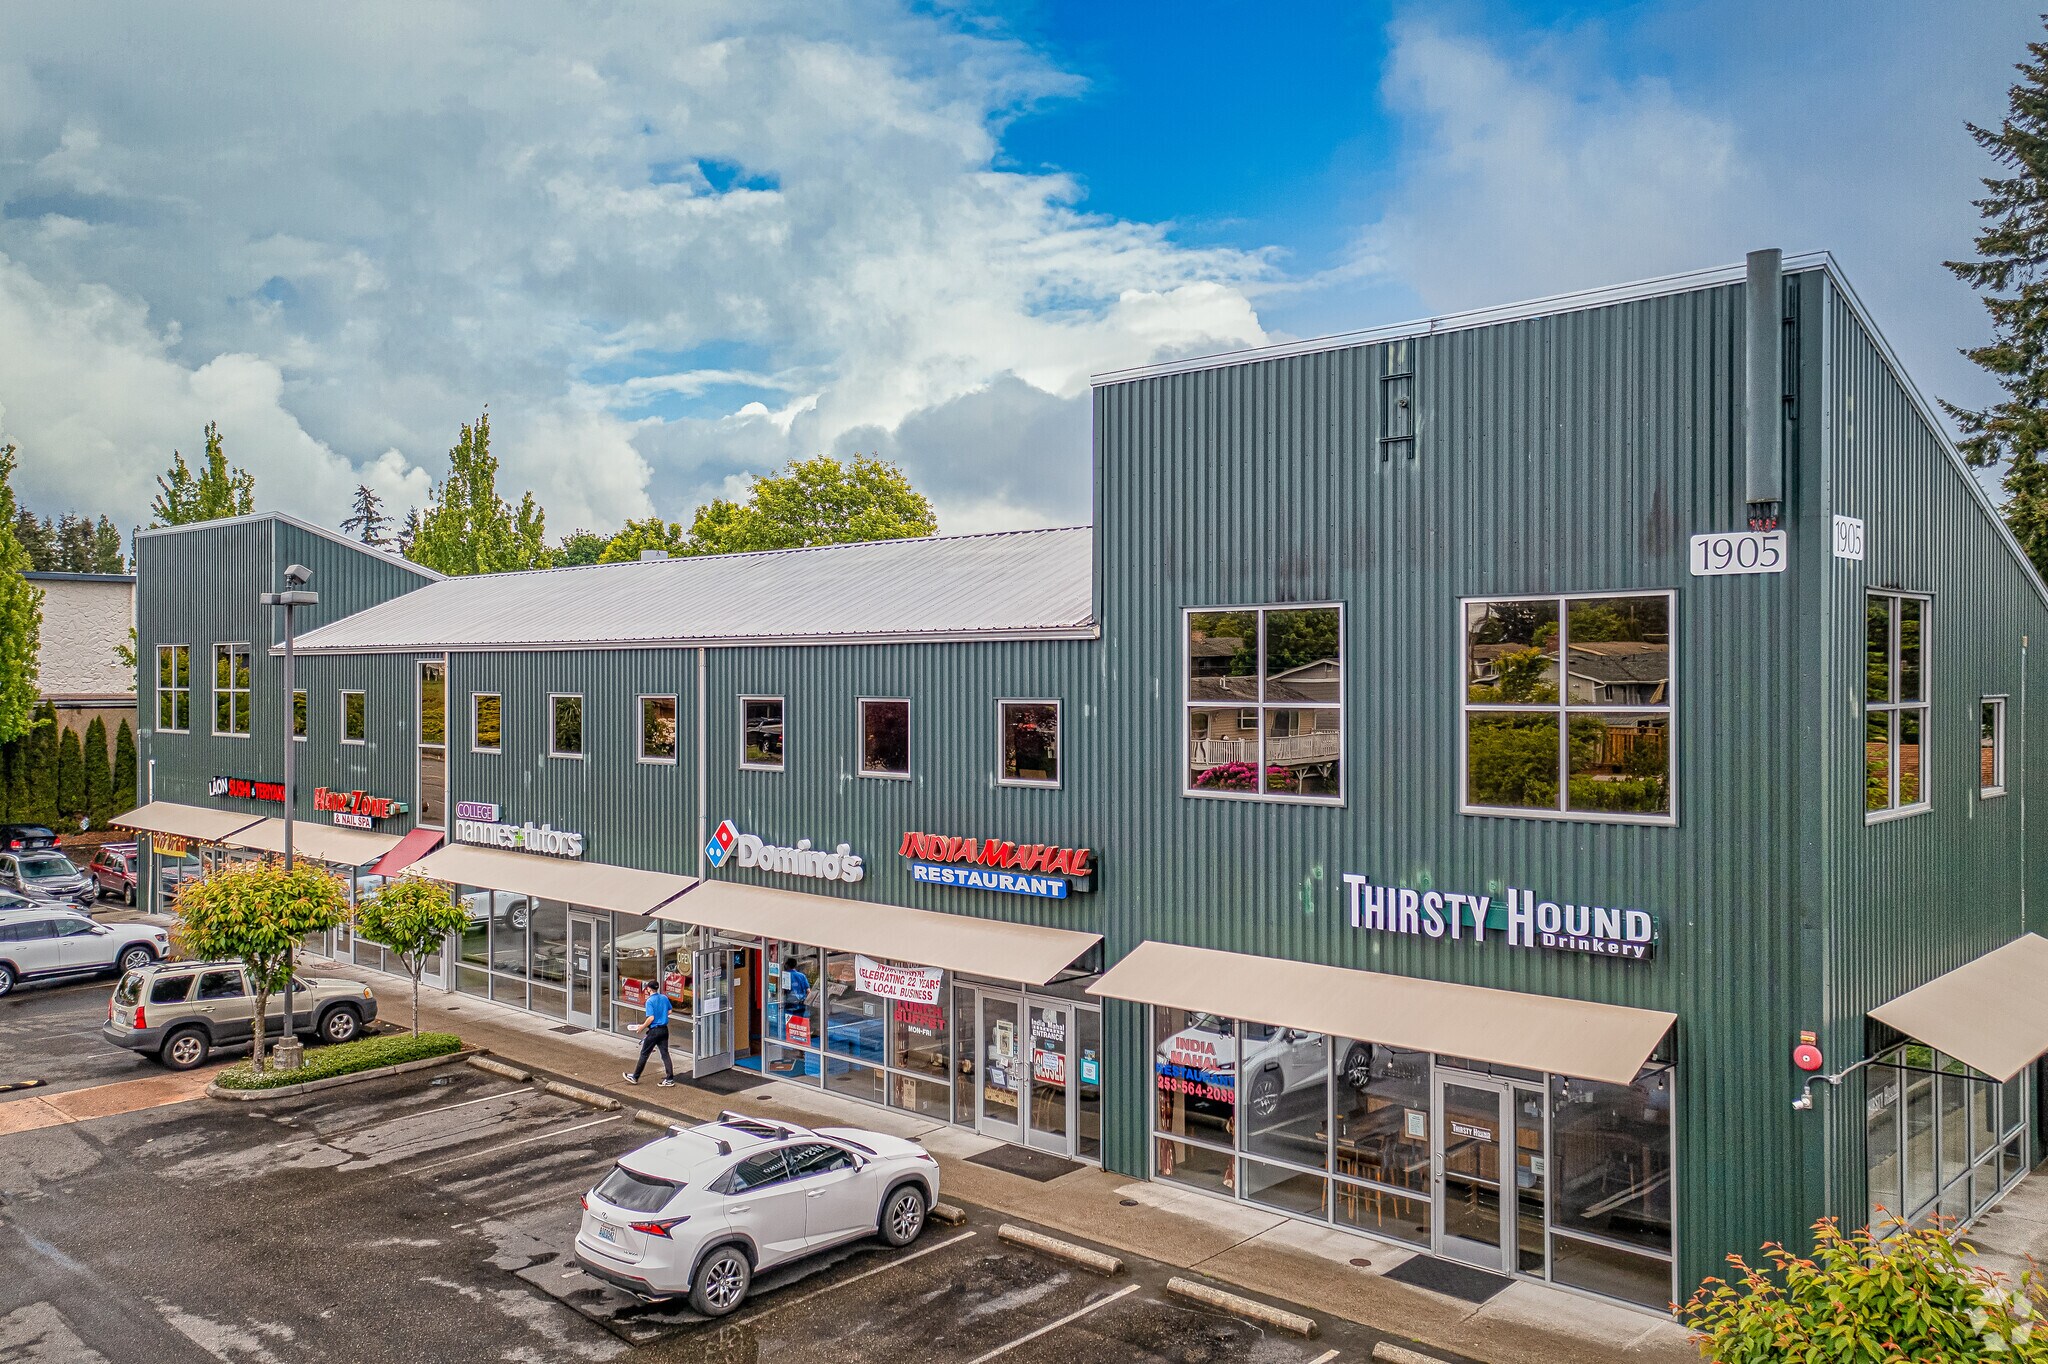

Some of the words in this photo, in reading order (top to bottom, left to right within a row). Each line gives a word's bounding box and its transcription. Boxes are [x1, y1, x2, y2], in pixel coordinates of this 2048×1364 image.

[1835, 521, 1861, 555] 1905
[1698, 536, 1780, 570] 1905
[351, 790, 390, 818] ZONE
[457, 803, 492, 820] COLLEGE
[335, 814, 340, 823] &
[341, 815, 357, 825] NAIL
[357, 817, 371, 828] SPA
[738, 834, 863, 883] Domino's
[898, 831, 977, 863] INDIA
[976, 839, 1090, 876] MAHAL
[914, 865, 1063, 897] RESTAURANT
[1343, 873, 1490, 942] THIRSTY
[1507, 888, 1652, 947] HOUND
[1542, 933, 1646, 958] Drinkery
[873, 982, 897, 995] LOCAL
[900, 988, 933, 1001] BUSINESS
[907, 978, 916, 987] 22
[897, 1000, 942, 1018] LUNCH
[894, 1010, 945, 1030] BUFFET
[908, 1025, 932, 1037] MON-FRI
[1032, 1029, 1063, 1042] ENTRANCE
[1176, 1037, 1216, 1055] INDIA
[1170, 1050, 1220, 1071] MAHAL
